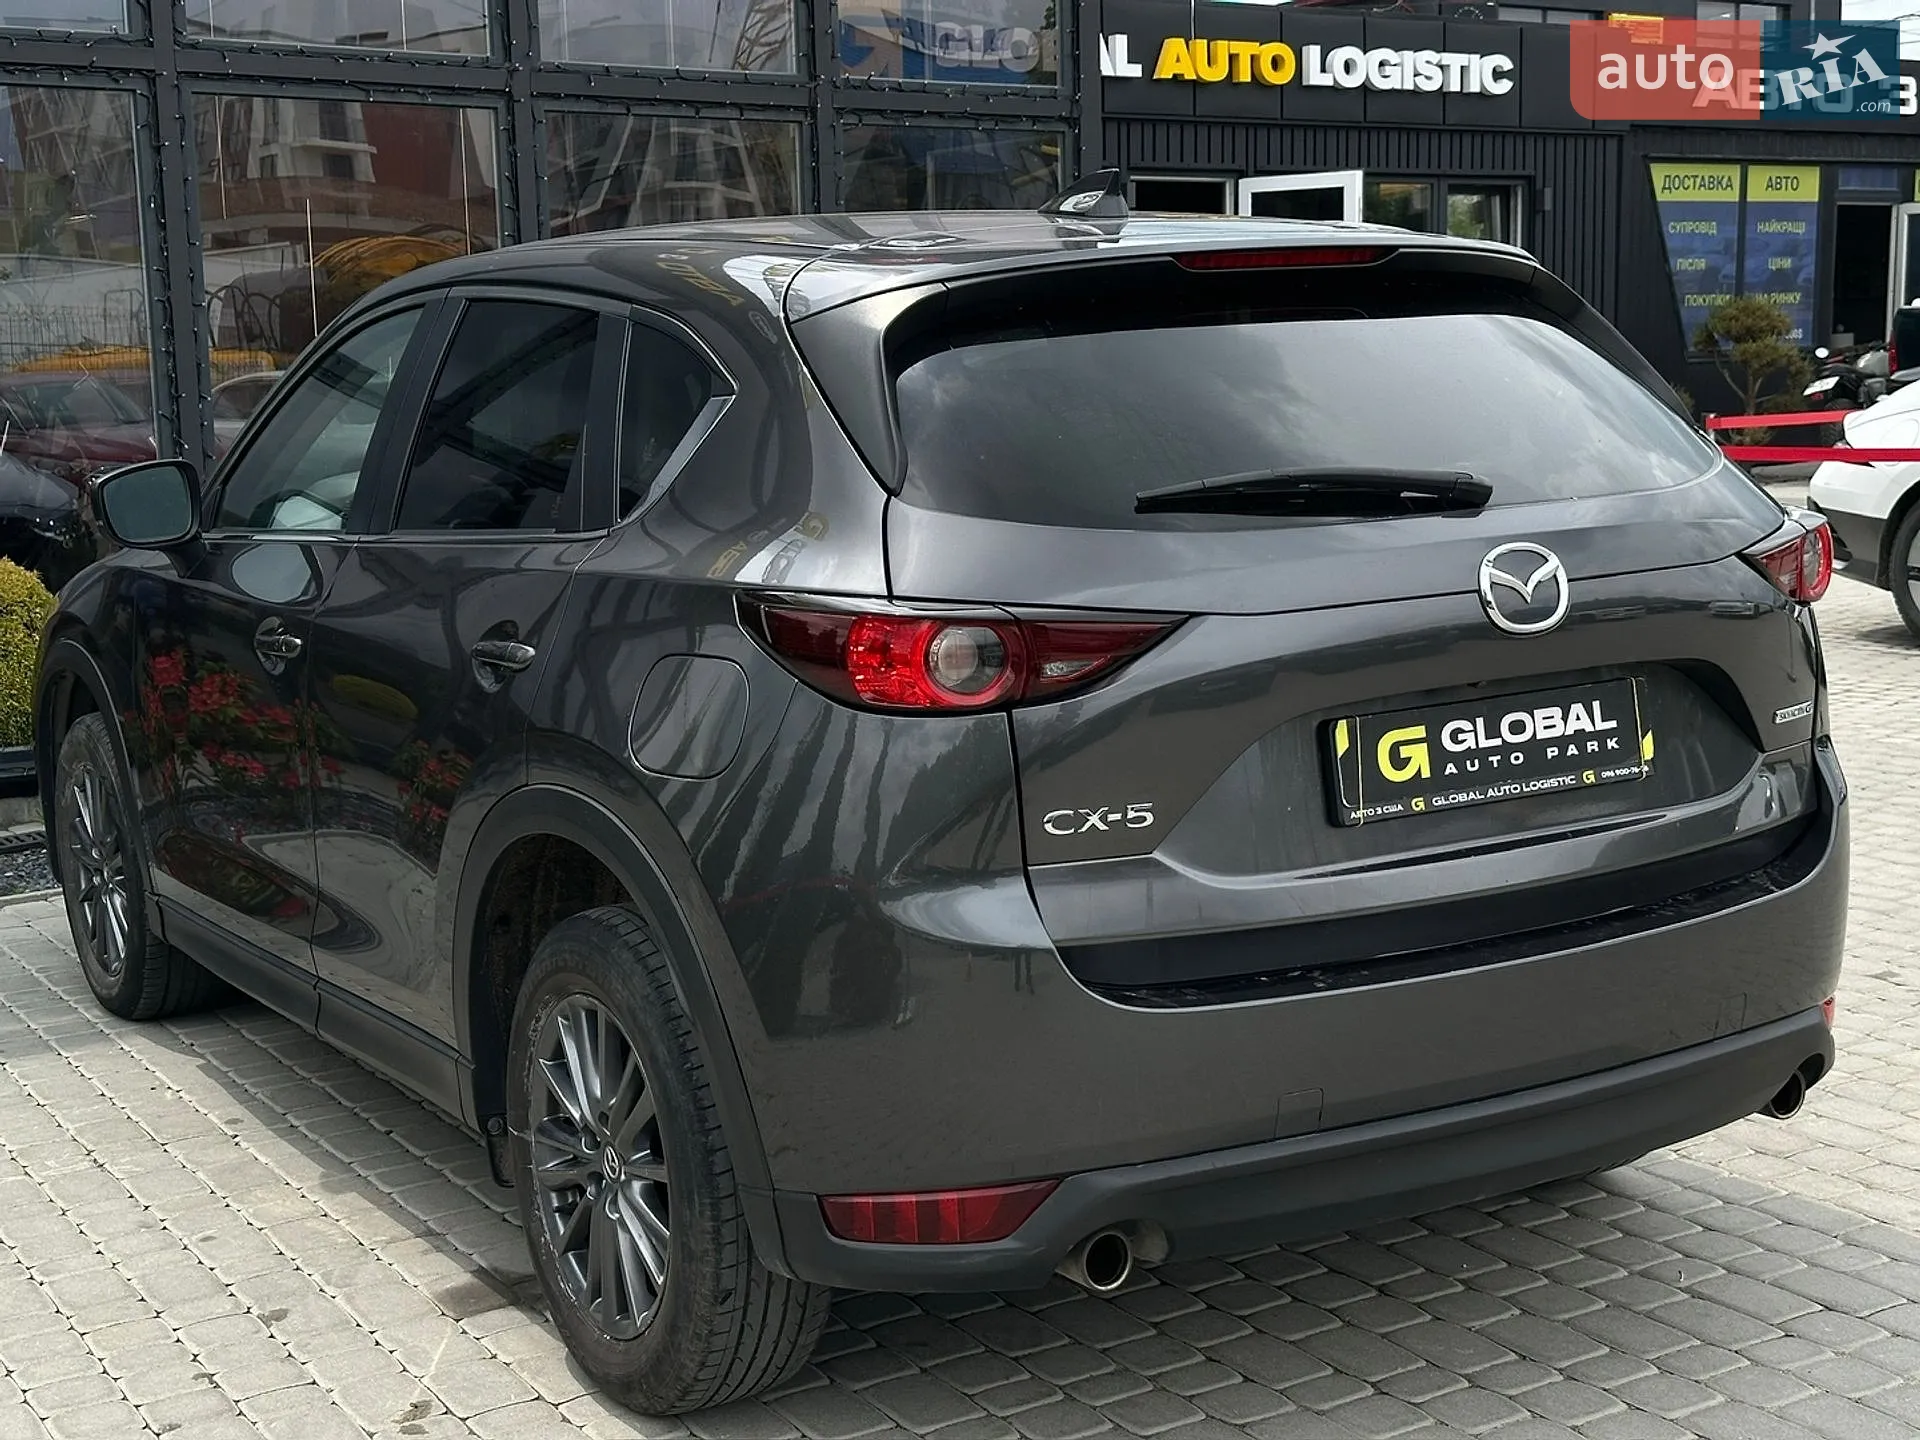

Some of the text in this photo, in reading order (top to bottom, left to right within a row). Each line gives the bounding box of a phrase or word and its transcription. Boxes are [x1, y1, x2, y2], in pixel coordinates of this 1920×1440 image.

[1153, 37, 1296, 86] AUTO
[1302, 44, 1515, 96] LOGISTIC
[1661, 174, 1734, 193] ДОСТАВКА
[1765, 175, 1800, 192] АВТО
[1668, 222, 1717, 235] СУПРОВІД
[1757, 219, 1805, 234] НАЙКРАЩІ
[1676, 258, 1706, 271] ПІСЛЯ
[1768, 257, 1792, 270] ЦІНИ
[1441, 700, 1617, 752] GLOBAL
[1444, 737, 1621, 776] AUTO PARK
[1432, 790, 1485, 806] GLOBAL
[1487, 783, 1521, 798] AUTO
[1522, 775, 1577, 792] LOGISTIC
[1043, 802, 1155, 835] CX-5
